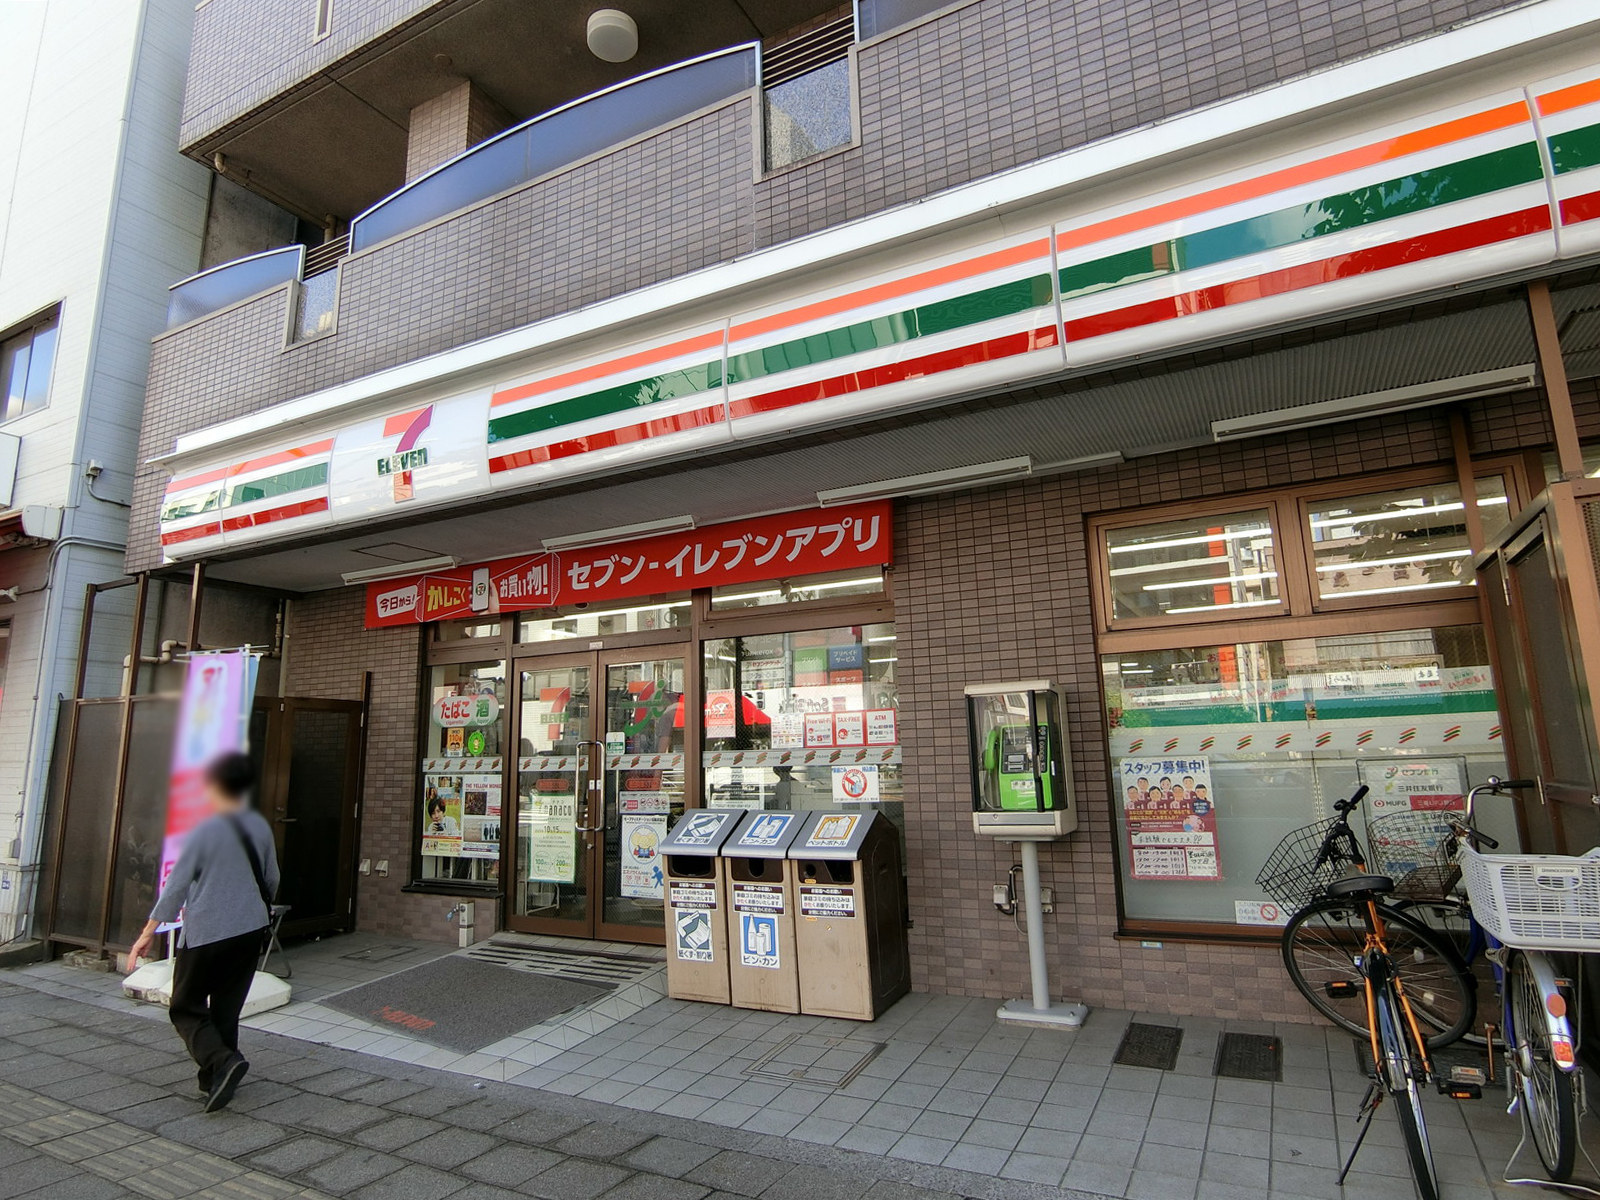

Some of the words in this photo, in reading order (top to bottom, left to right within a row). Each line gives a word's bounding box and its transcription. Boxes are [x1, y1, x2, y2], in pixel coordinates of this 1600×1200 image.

[499, 562, 548, 598] お買い物!
[379, 594, 417, 613] 今日から!
[427, 585, 466, 612] かしこく
[441, 700, 470, 719] たばこ
[476, 699, 489, 717] 酒
[1124, 760, 1206, 775] スタッフ募集中!
[1398, 784, 1443, 792] 三井住友銀行
[743, 955, 778, 966] ビン・カン
